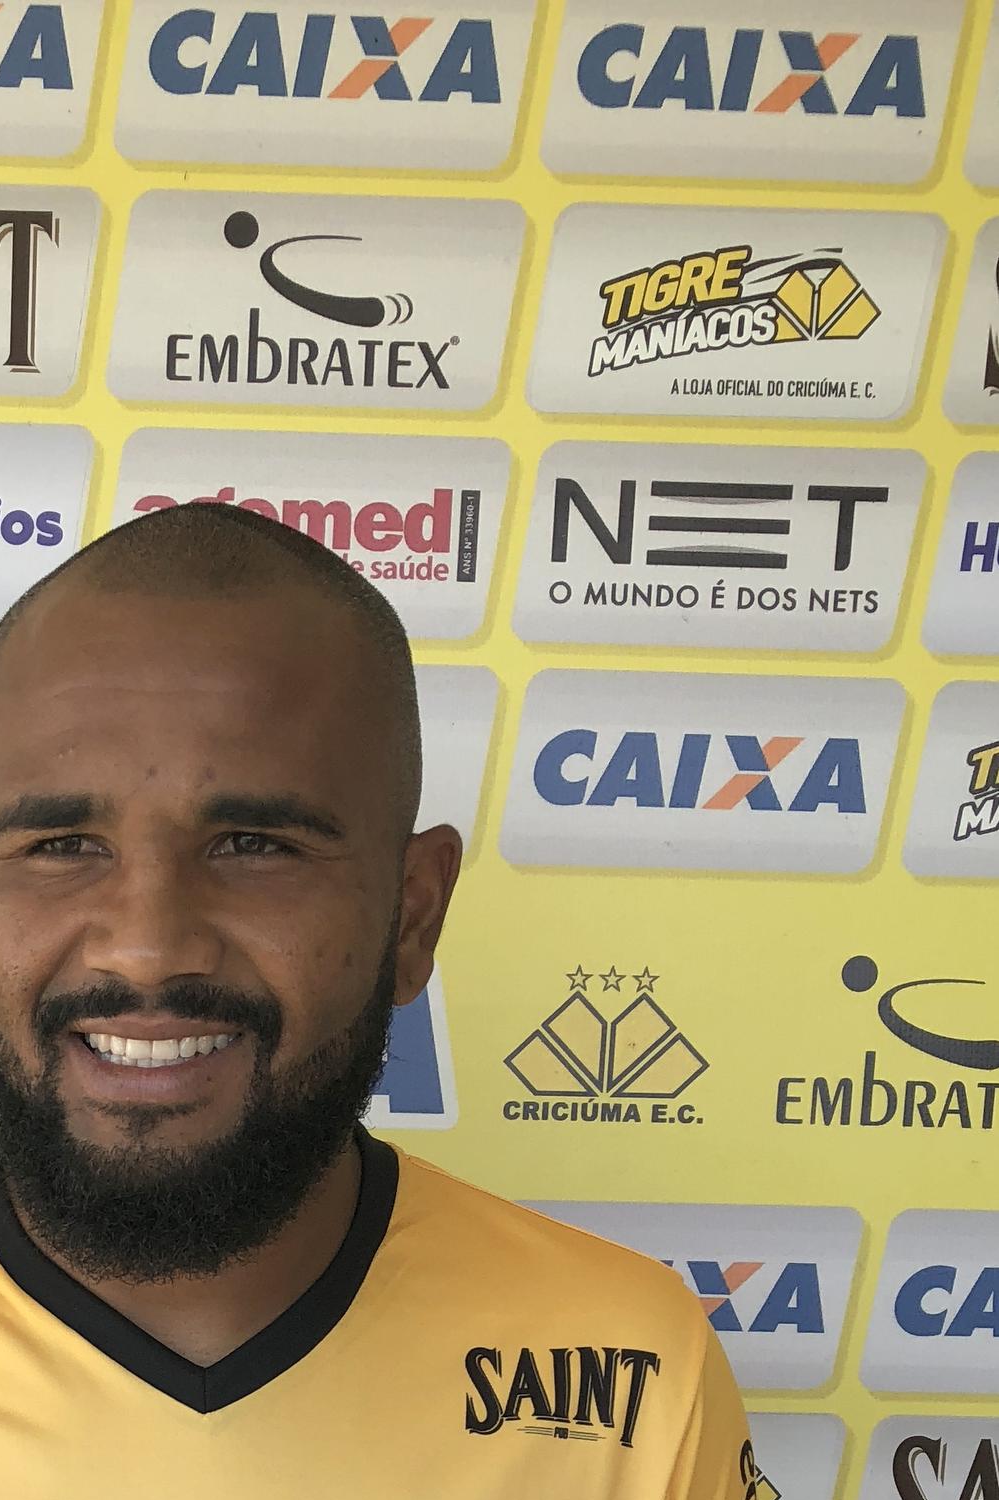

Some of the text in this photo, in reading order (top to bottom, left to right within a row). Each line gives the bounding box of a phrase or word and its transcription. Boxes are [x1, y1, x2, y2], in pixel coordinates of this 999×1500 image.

[149, 9, 501, 104] CAIXA
[577, 24, 926, 118] CAIXA
[600, 245, 752, 329] TIGRE
[587, 304, 777, 377] MANÍACOS
[683, 379, 712, 395] LOJA
[717, 380, 763, 396] OFICIAL
[767, 380, 783, 396] DO
[787, 378, 846, 398] CRICIÚMA
[551, 478, 889, 571] NET
[370, 555, 449, 582] saúde
[549, 580, 879, 613] O MUNDO É DOS NETS
[533, 728, 866, 813] CAIXA
[503, 1099, 703, 1124] CRICIÚMA E.C.
[465, 1347, 661, 1448] SAINT
